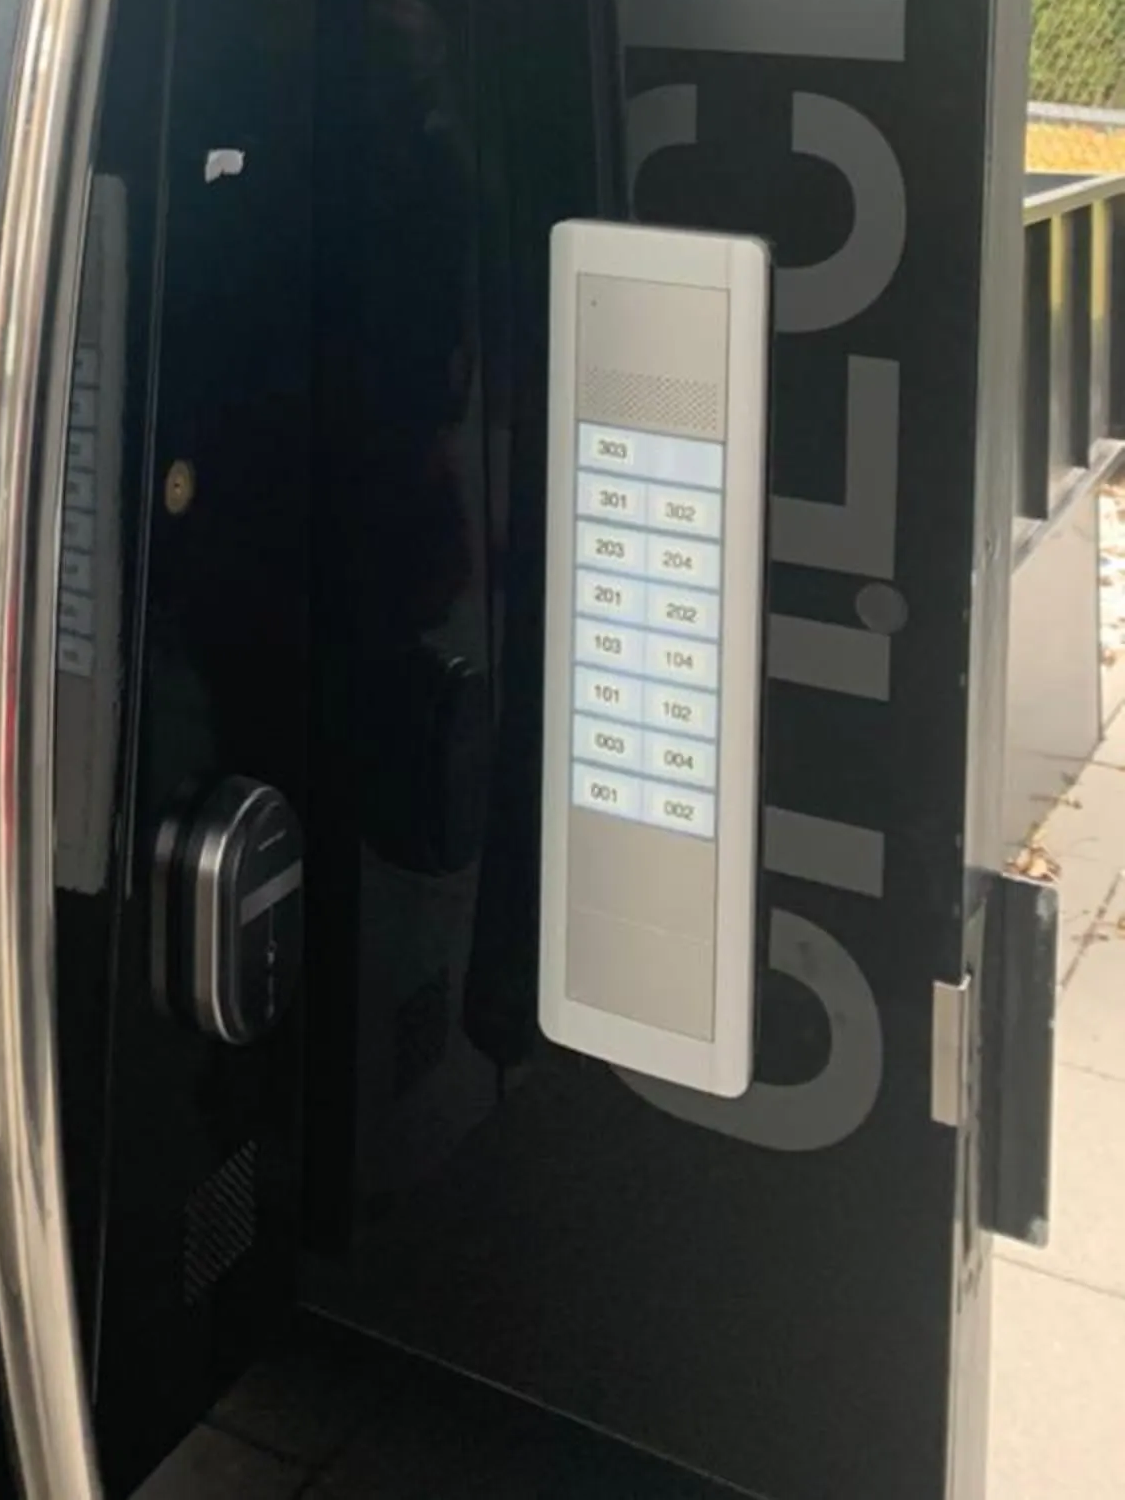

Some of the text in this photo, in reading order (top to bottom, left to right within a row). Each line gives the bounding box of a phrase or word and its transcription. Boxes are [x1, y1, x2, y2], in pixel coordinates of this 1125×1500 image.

[598, 439, 628, 459] 303
[600, 490, 627, 509] 301
[665, 502, 696, 522] 302
[595, 539, 625, 558] 203
[662, 550, 693, 570] 204
[595, 585, 621, 606] 201
[666, 602, 697, 623] 202
[594, 635, 622, 654] 103
[666, 651, 694, 669] 104
[594, 684, 620, 703] 101
[662, 701, 692, 721] 102
[594, 733, 625, 754] 003
[663, 750, 694, 770] 004
[590, 782, 618, 803] 001
[663, 800, 695, 821] 002
